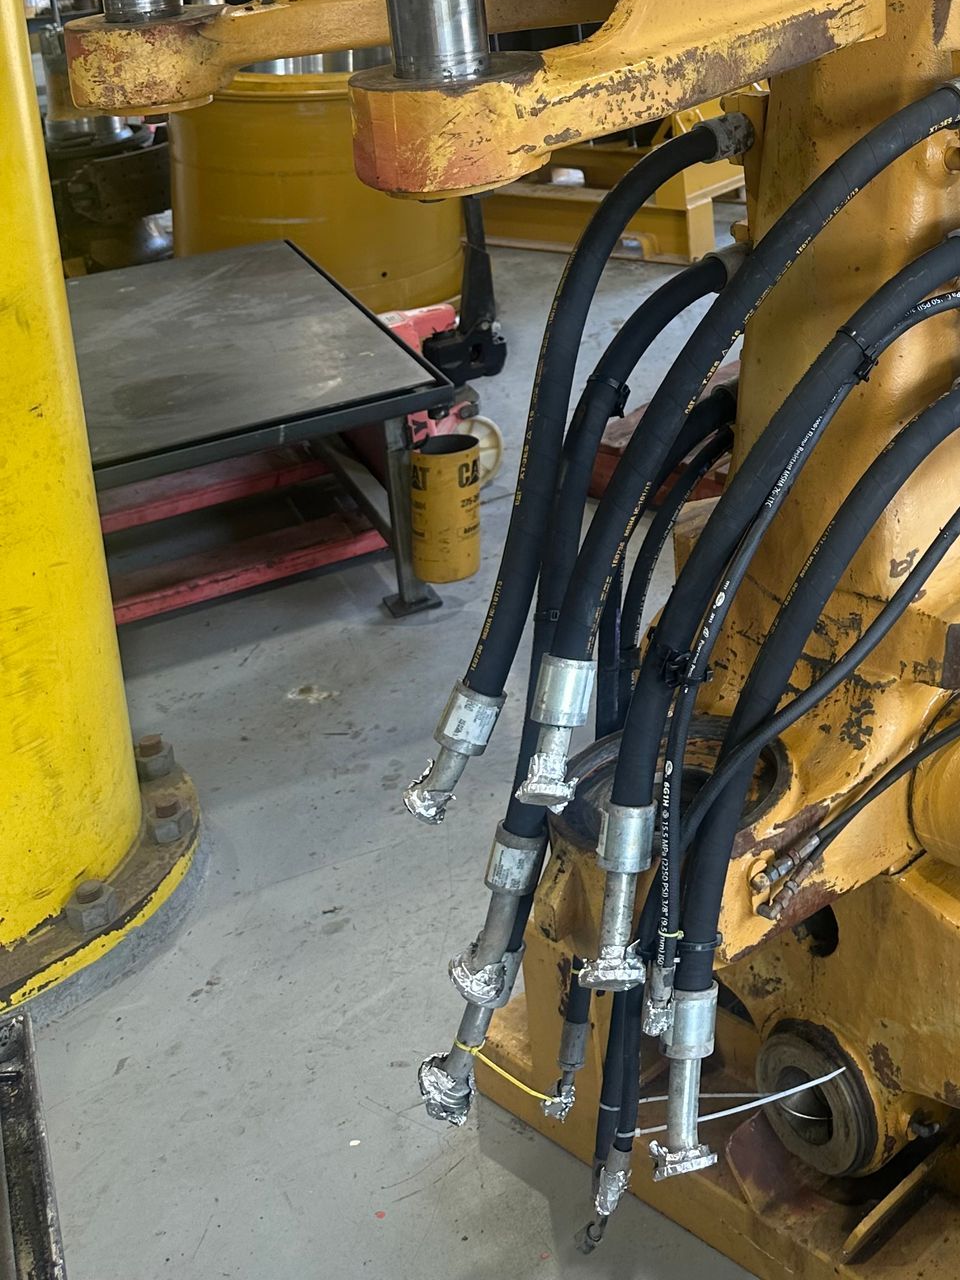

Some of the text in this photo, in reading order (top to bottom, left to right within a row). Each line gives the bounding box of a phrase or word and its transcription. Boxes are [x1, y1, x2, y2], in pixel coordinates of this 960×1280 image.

[411, 465, 430, 491] AT
[458, 461, 480, 489] CA
[775, 468, 791, 488] MSHA
[621, 512, 637, 538] MSHA
[480, 616, 493, 640] MSHA
[661, 780, 671, 807] 6G1H
[660, 820, 669, 837] 15.5
[660, 838, 669, 856] MPa
[660, 857, 670, 881] (2250
[660, 898, 670, 916] 3/8"
[658, 916, 669, 932] (9.5
